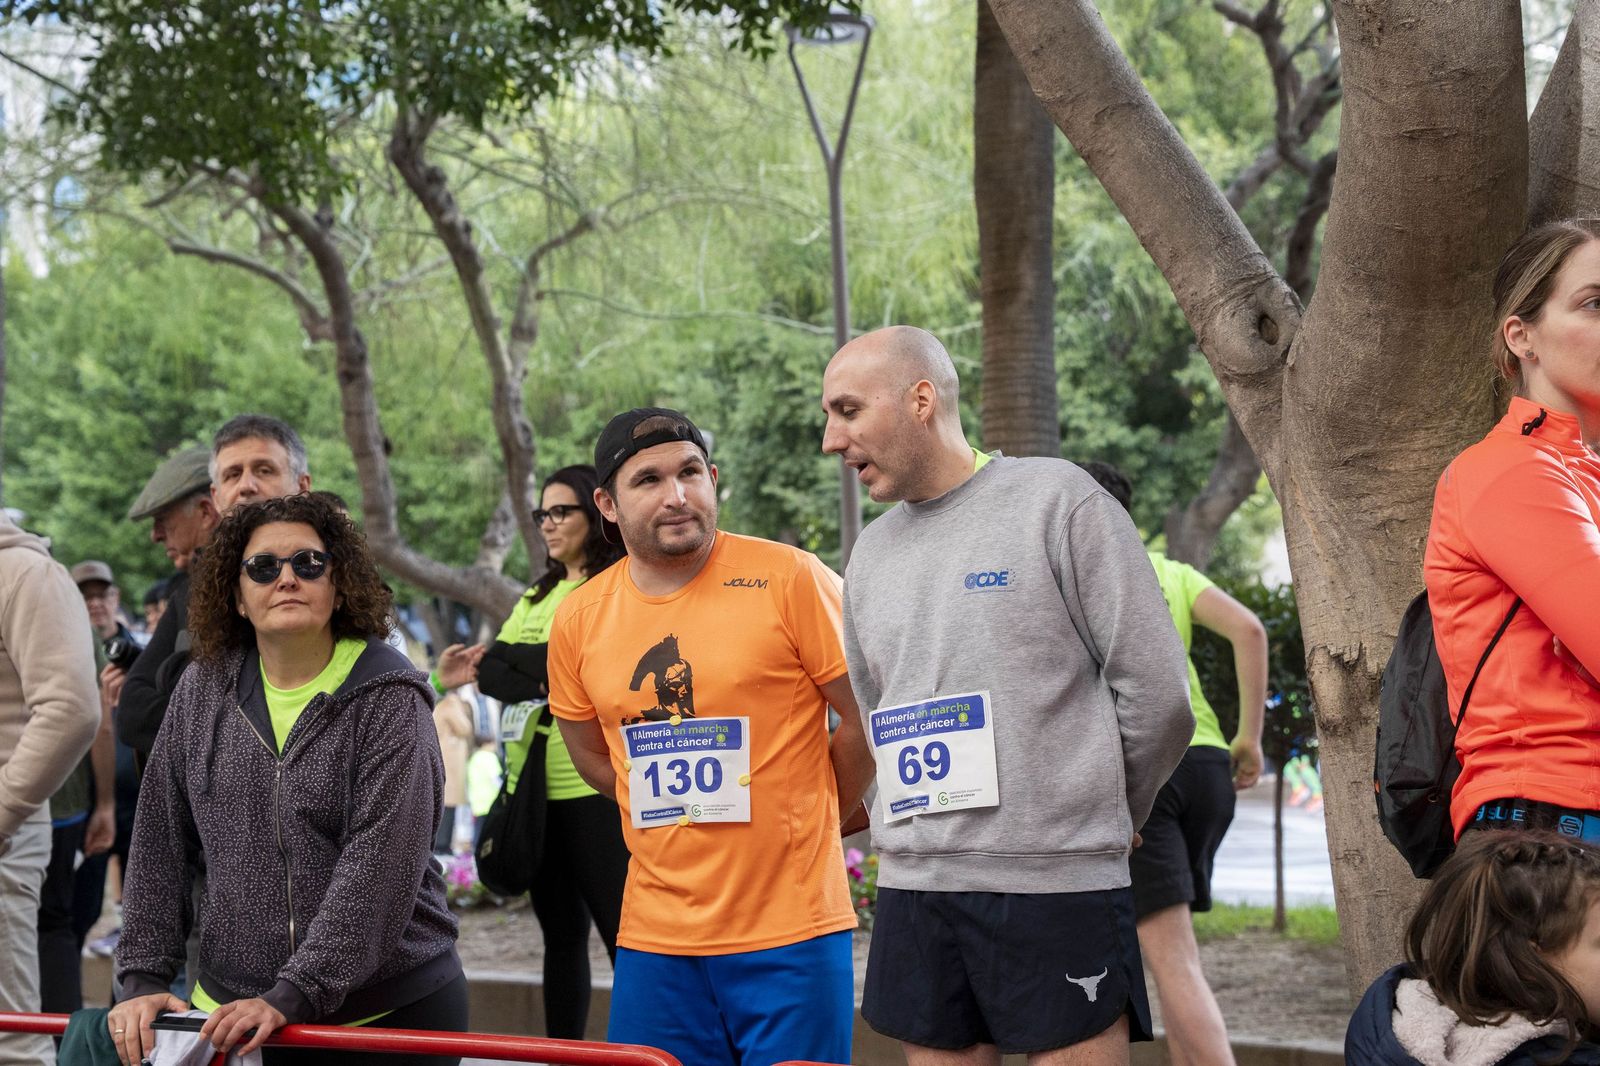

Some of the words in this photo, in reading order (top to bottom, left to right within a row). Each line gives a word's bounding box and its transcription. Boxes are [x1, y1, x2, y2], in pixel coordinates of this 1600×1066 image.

[881, 711, 915, 726] Almería
[915, 710, 928, 719] en
[930, 702, 970, 716] marcha
[637, 727, 671, 739] Almería
[673, 727, 686, 735] en
[688, 724, 729, 734] marcha
[880, 725, 906, 739] contra
[908, 722, 918, 733] el
[920, 718, 955, 731] cáncer
[636, 741, 663, 752] contra
[665, 738, 675, 749] el
[677, 737, 713, 747] cáncer
[898, 741, 951, 786] 69
[643, 756, 723, 798] 130
